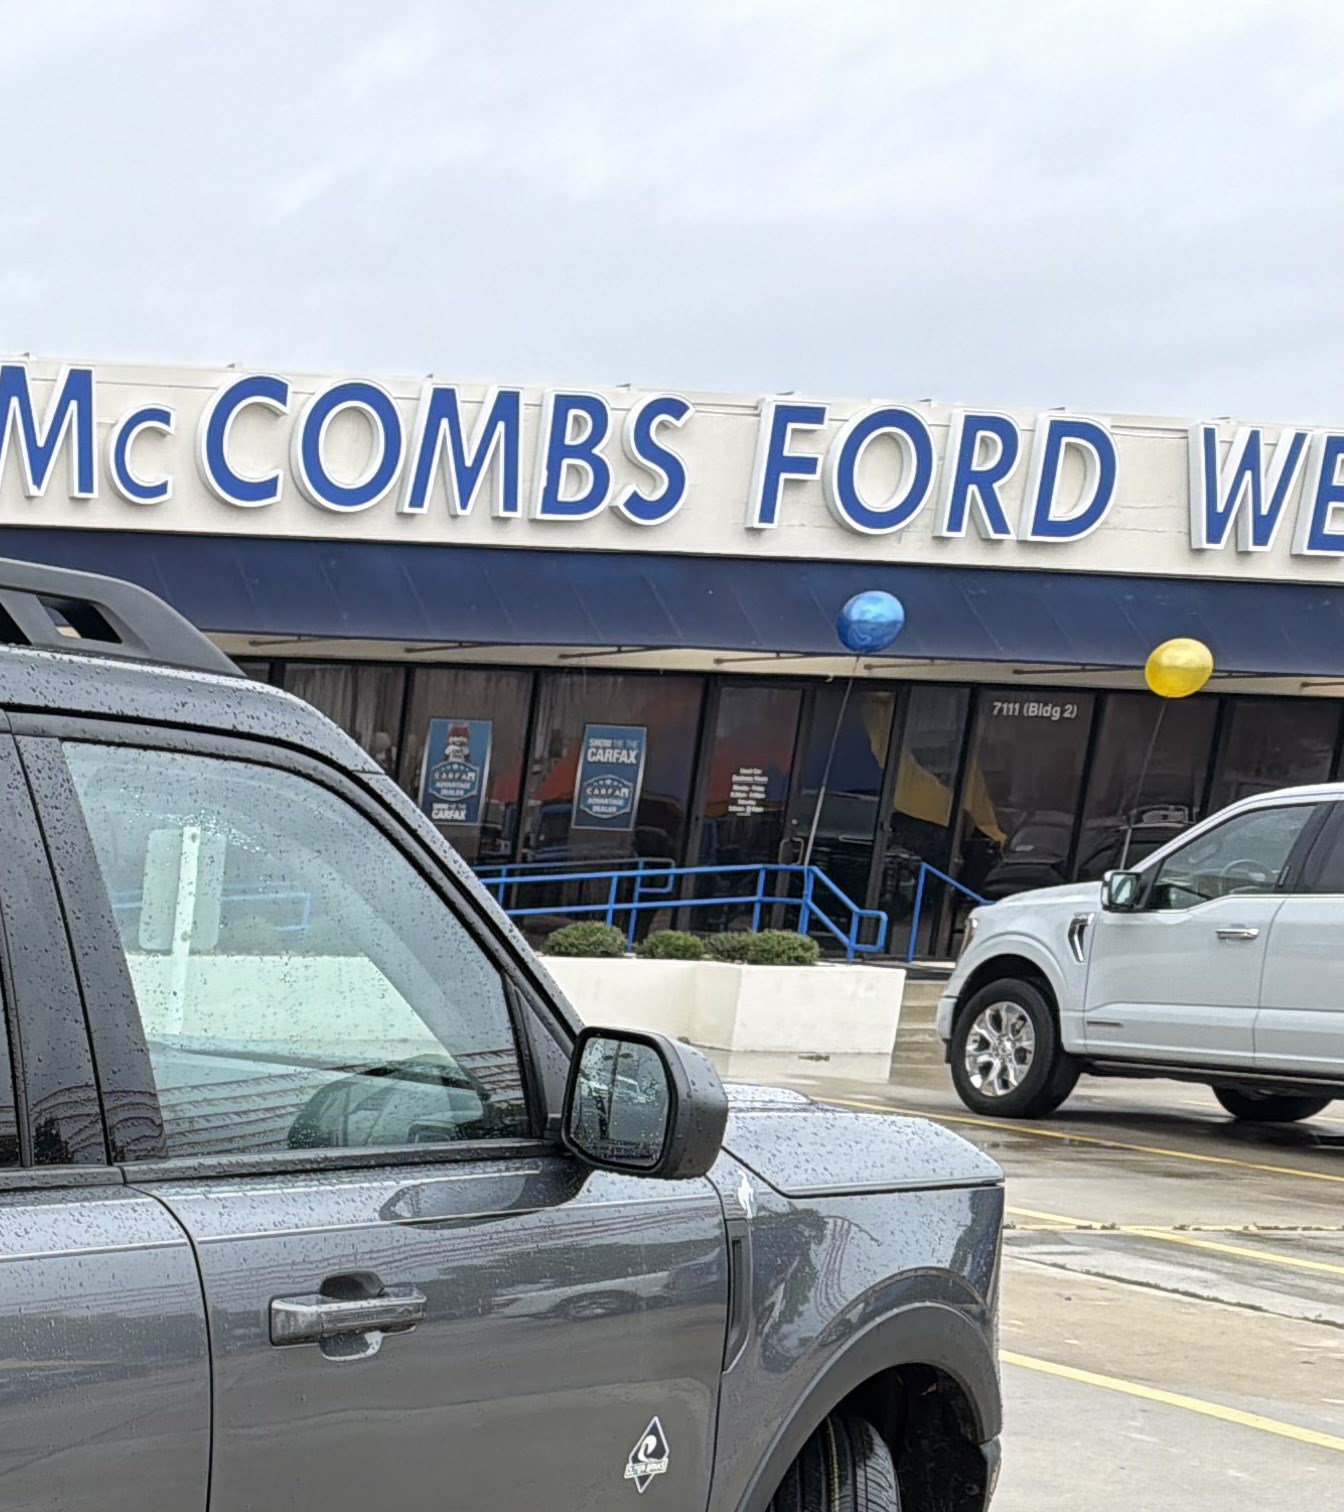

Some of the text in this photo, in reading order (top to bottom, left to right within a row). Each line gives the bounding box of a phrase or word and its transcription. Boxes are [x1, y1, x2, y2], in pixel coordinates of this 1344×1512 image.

[746, 398, 1120, 543] FORD
[992, 701, 1078, 721] 7111 (Bldg 2)
[588, 738, 612, 748] SHOW
[587, 748, 640, 764] CARFAX
[434, 770, 476, 783] CARFAX
[585, 787, 630, 799] CARFAX
[431, 809, 467, 821] CARFAX
